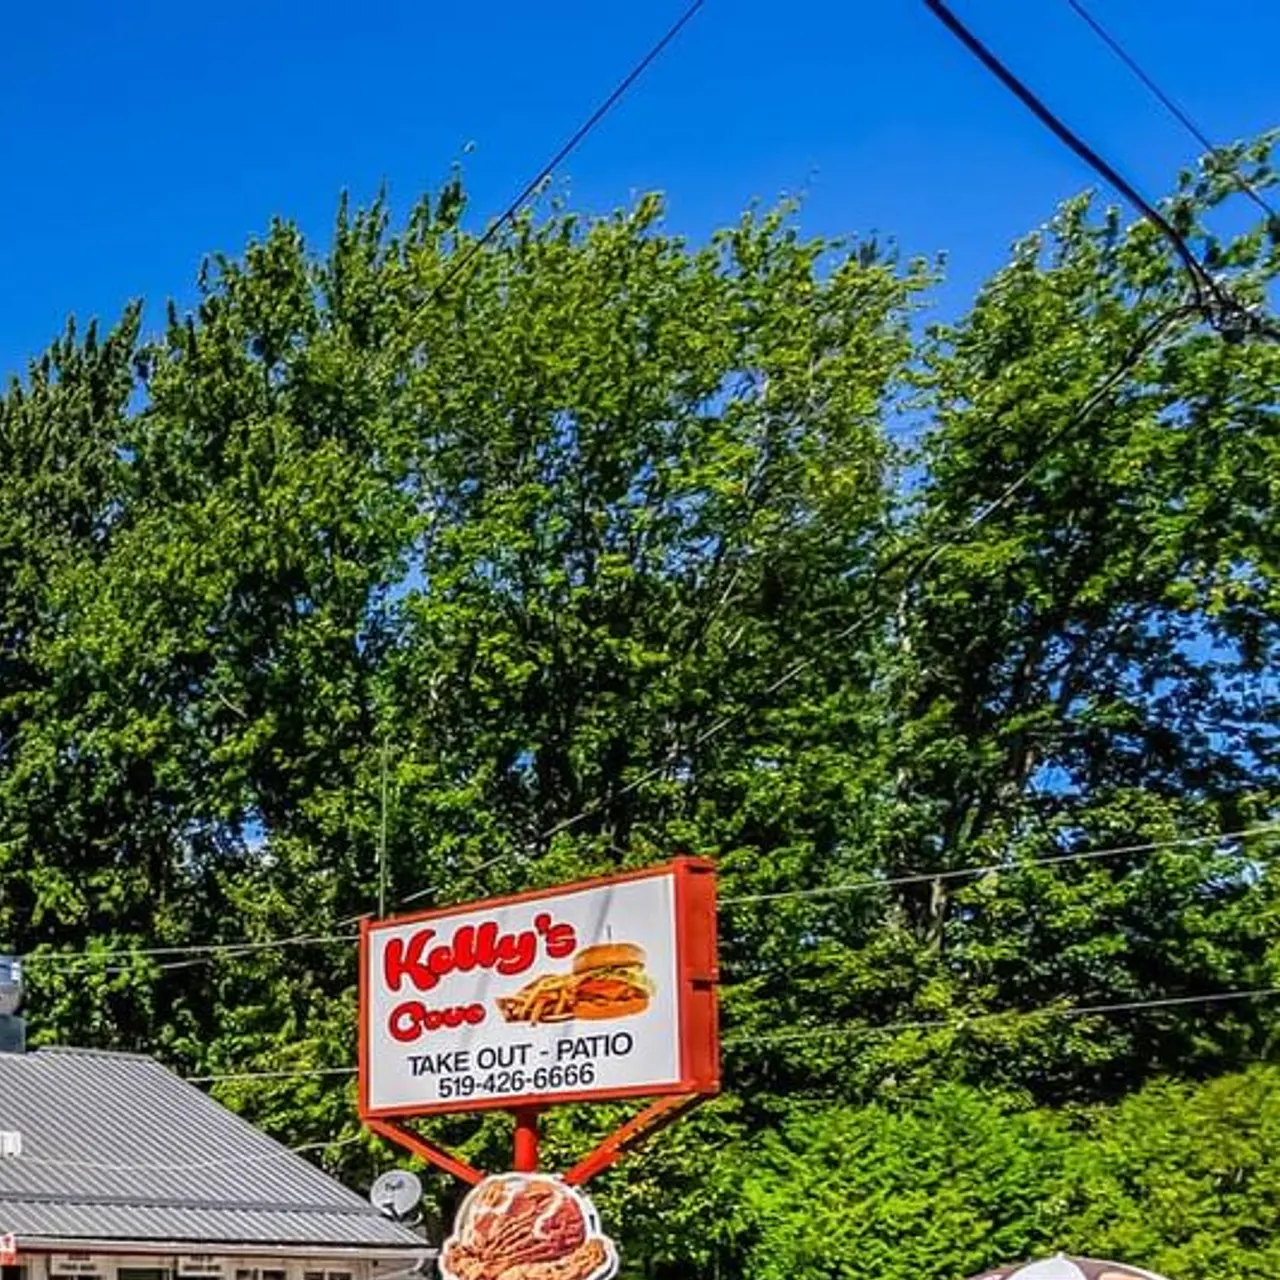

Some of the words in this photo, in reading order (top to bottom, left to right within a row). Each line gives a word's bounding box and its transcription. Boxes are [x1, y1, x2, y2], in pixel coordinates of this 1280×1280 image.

[383, 914, 576, 991] Kelly's
[388, 1000, 485, 1043] Cove
[408, 1052, 470, 1077] TAKE
[475, 1044, 532, 1070] OUT
[556, 1032, 633, 1062] PATIO
[438, 1063, 595, 1099] 519-426-6666
